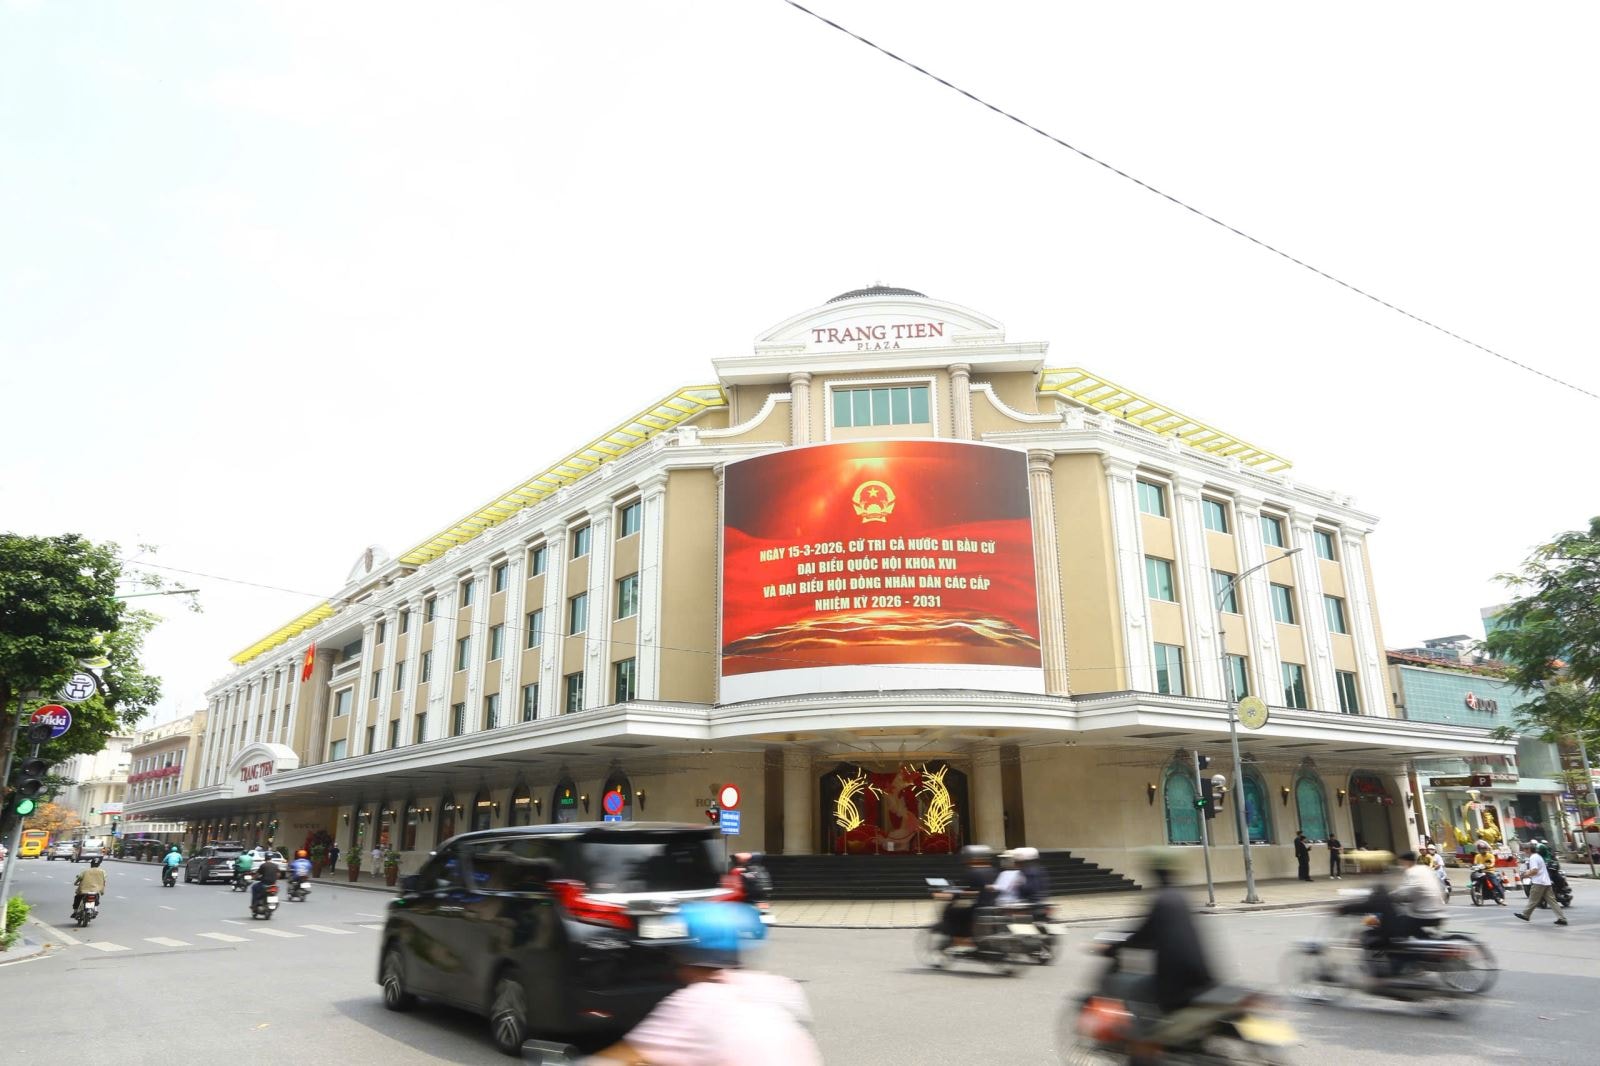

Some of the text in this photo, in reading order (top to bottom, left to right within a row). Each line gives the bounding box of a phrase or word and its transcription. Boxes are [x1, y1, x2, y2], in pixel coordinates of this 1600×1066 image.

[812, 322, 944, 344] TRANG TIEN
[857, 341, 901, 351] PLAZA
[760, 547, 785, 562] NGÀY
[868, 539, 886, 551] TRI
[908, 537, 939, 551] NƯỚC
[941, 539, 954, 551] ĐI
[797, 562, 816, 576] ĐẠI
[818, 556, 844, 573] BIỂU
[847, 555, 879, 572] QUỐC
[881, 556, 902, 571] HỘI
[938, 557, 957, 570] XVI
[763, 574, 991, 598] VÀ ĐẠI BIỂU HỘI ĐỒNG NHÂN DÂN CÁC CẤP
[815, 596, 850, 612] NHIỆM
[871, 595, 902, 608] 2026
[912, 595, 942, 608] 2031
